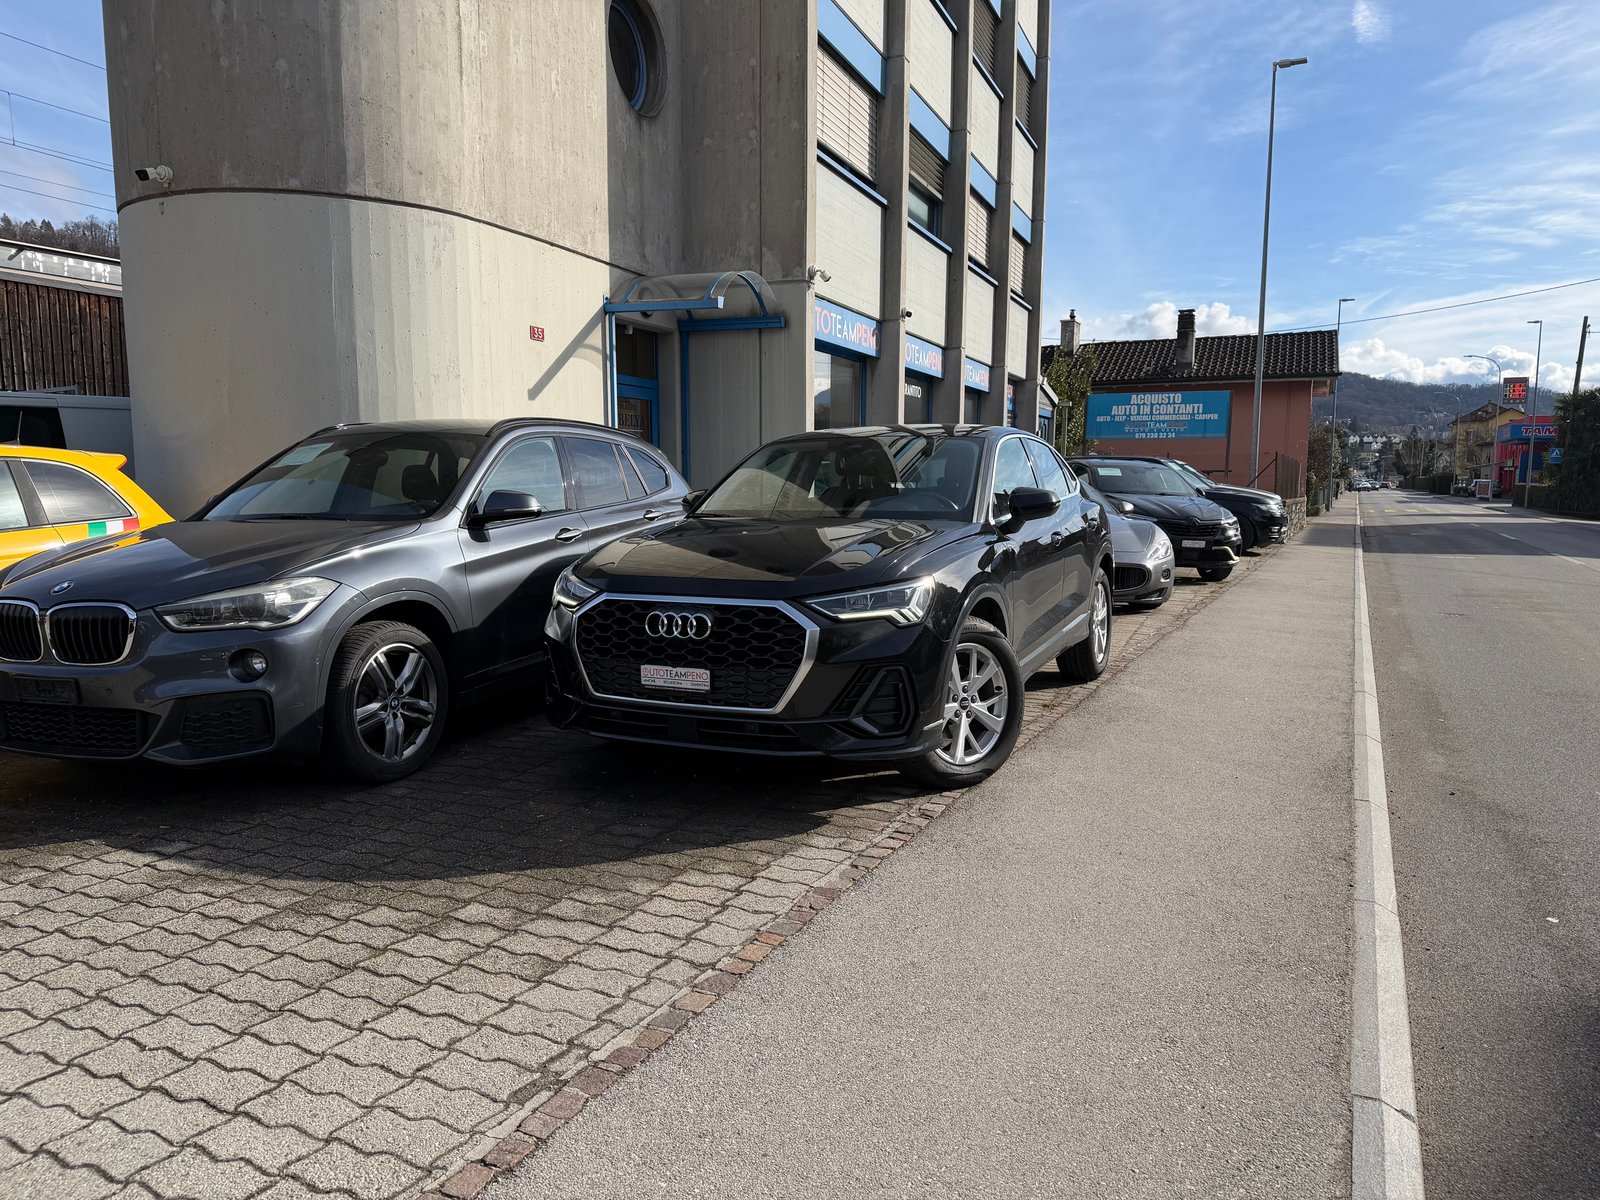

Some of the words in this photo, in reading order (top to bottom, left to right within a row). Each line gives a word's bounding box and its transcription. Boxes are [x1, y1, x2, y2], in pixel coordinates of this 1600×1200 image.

[533, 327, 543, 339] 35
[815, 306, 881, 350] TOTEAMPENO
[1130, 393, 1182, 404] ACQUISTO
[1111, 405, 1138, 415] AUTO
[1140, 404, 1151, 415] IN
[1152, 403, 1203, 415] CONTANTI
[1152, 413, 1191, 421] COMMERCIALI
